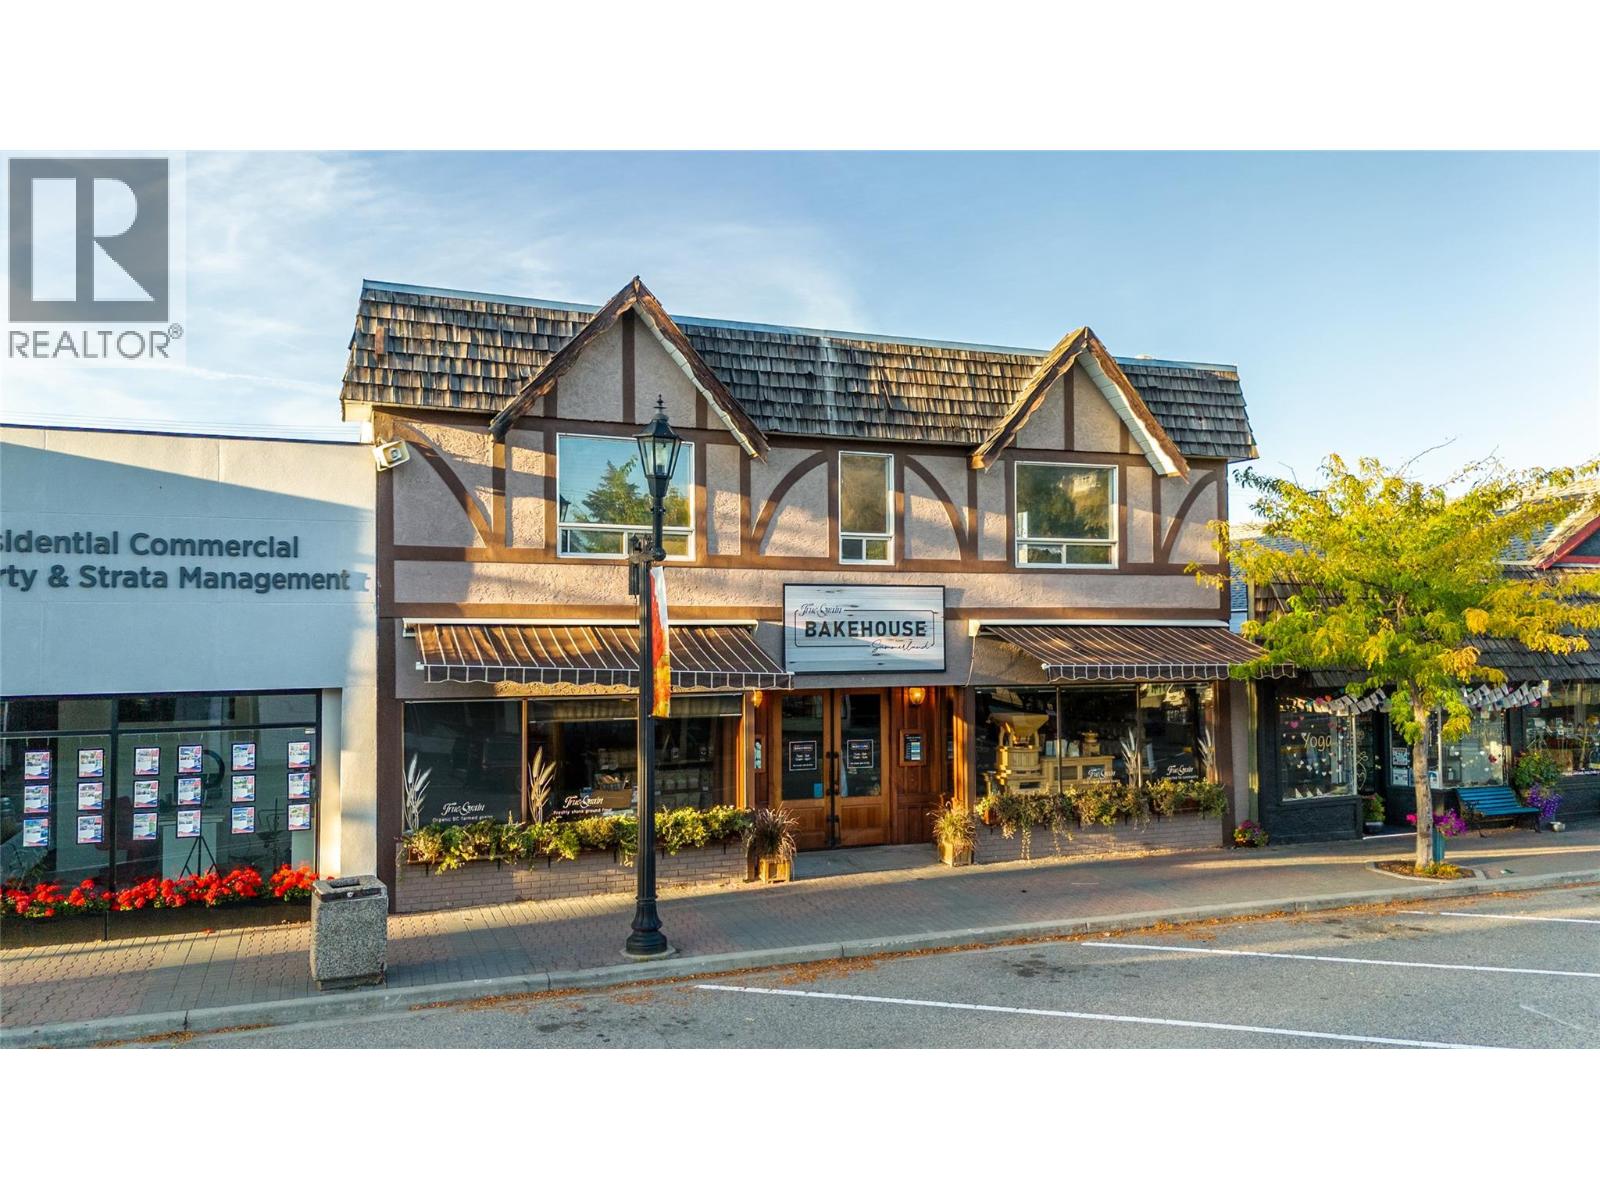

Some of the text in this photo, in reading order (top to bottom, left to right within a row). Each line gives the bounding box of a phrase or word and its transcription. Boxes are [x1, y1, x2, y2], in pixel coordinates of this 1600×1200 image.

[129, 532, 299, 558] Commercial
[47, 564, 69, 588] &
[78, 565, 168, 589] Strata
[179, 566, 350, 594] Management
[805, 621, 926, 637] BAKEHOUSE
[1301, 732, 1332, 752] Yoga
